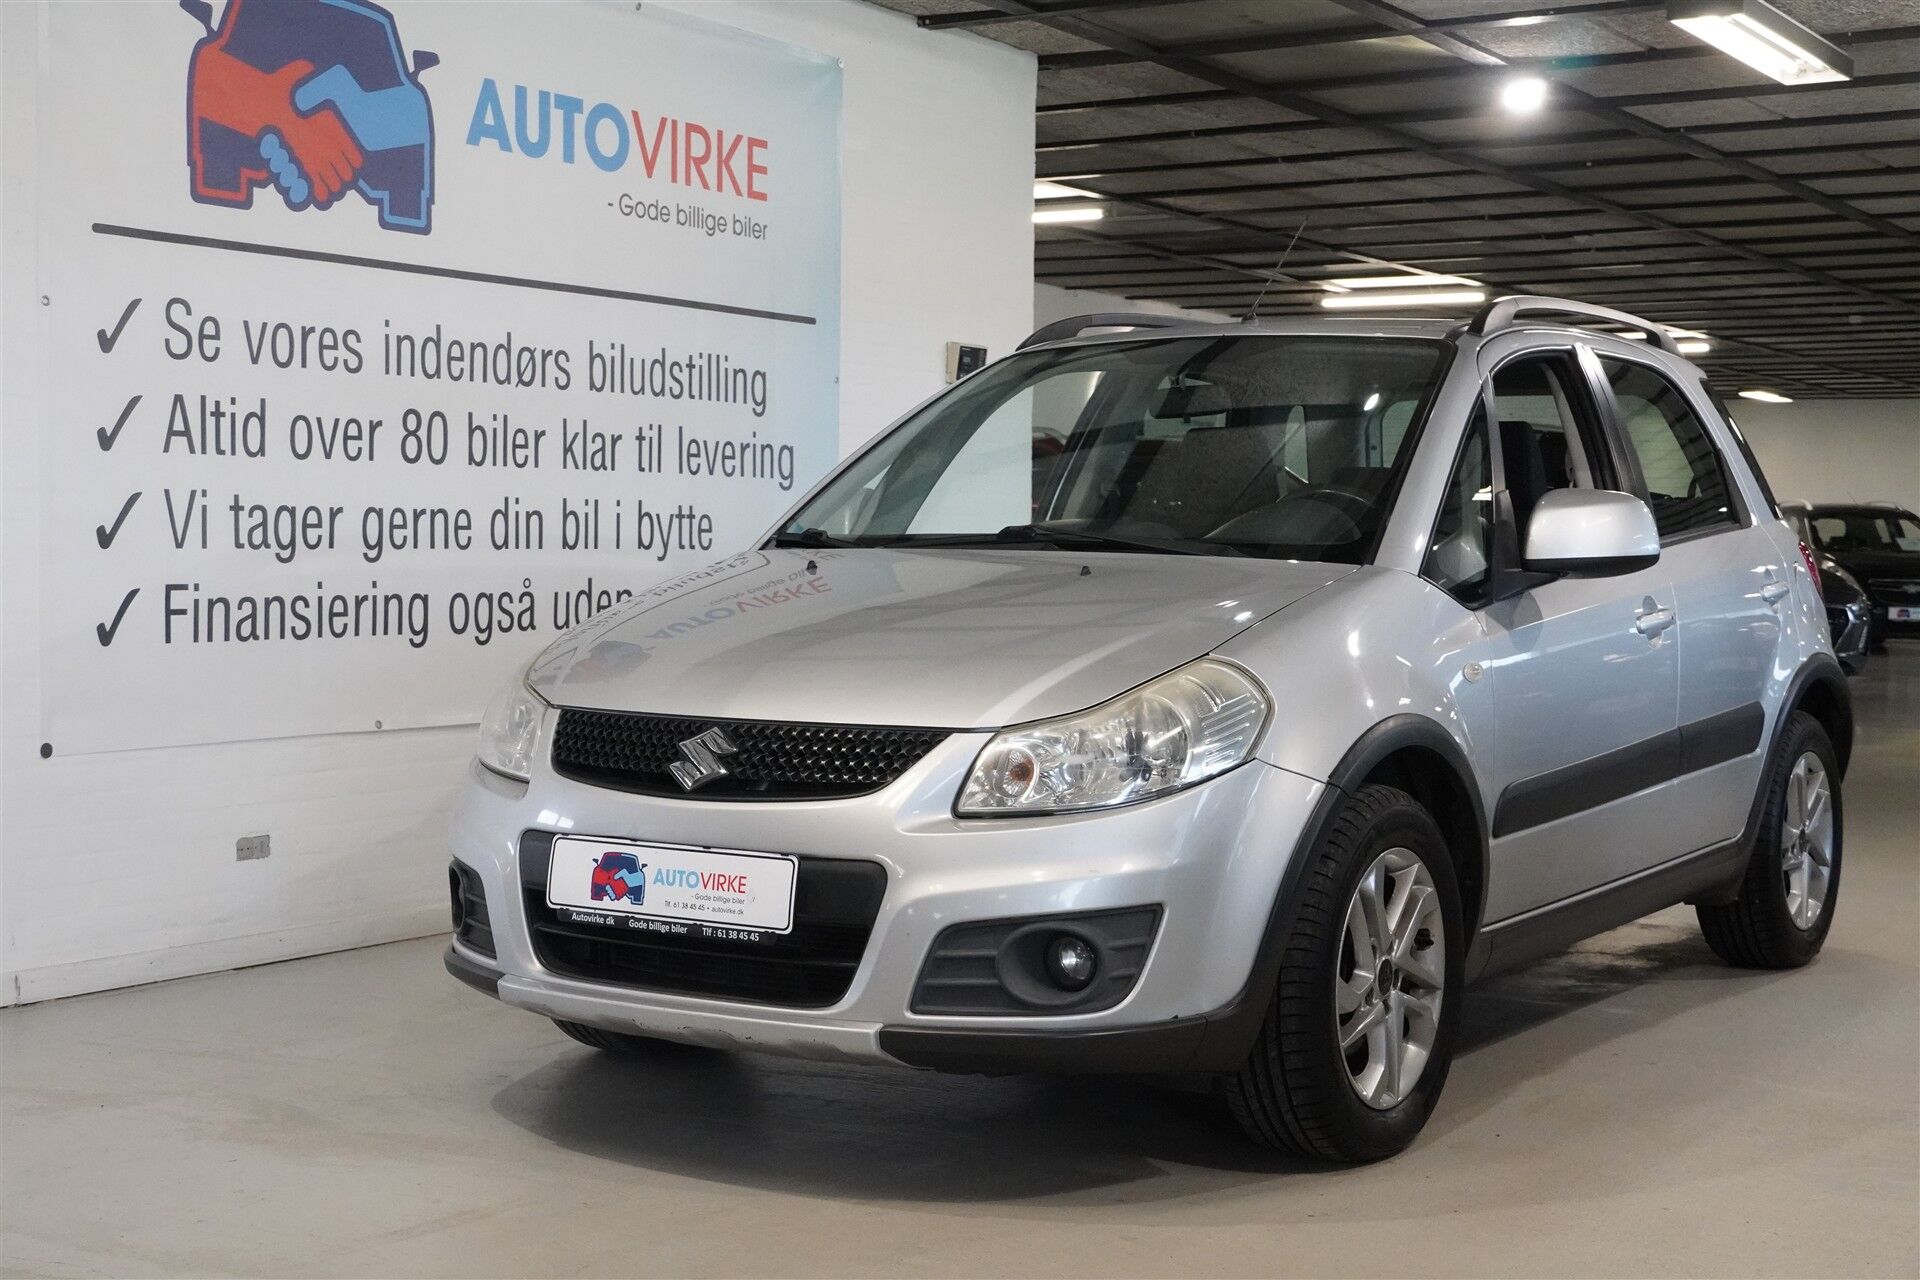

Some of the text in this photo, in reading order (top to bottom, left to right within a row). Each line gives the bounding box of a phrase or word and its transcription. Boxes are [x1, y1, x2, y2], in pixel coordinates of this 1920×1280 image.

[467, 78, 769, 202] AUTOVIRKE
[618, 194, 671, 224] Gode
[675, 202, 728, 237] billige
[732, 213, 769, 241] biler
[164, 297, 768, 419] Se vores indendørs biludstilling
[162, 394, 795, 488] Altid over 80 biler klar til levering
[163, 488, 714, 563] Vi tager gerne din bil i bytte
[164, 581, 428, 650] Finansiering
[448, 577, 537, 648] også
[653, 867, 747, 894] AUTOVIRKE
[694, 893, 712, 902] Gode
[712, 895, 731, 905] billige
[628, 919, 688, 934] Gode billige biler
[681, 902, 689, 910] 38
[689, 902, 697, 911] 45
[717, 929, 727, 938] 61
[728, 930, 738, 939] 38
[739, 931, 748, 940] 45
[749, 932, 760, 942] 45
